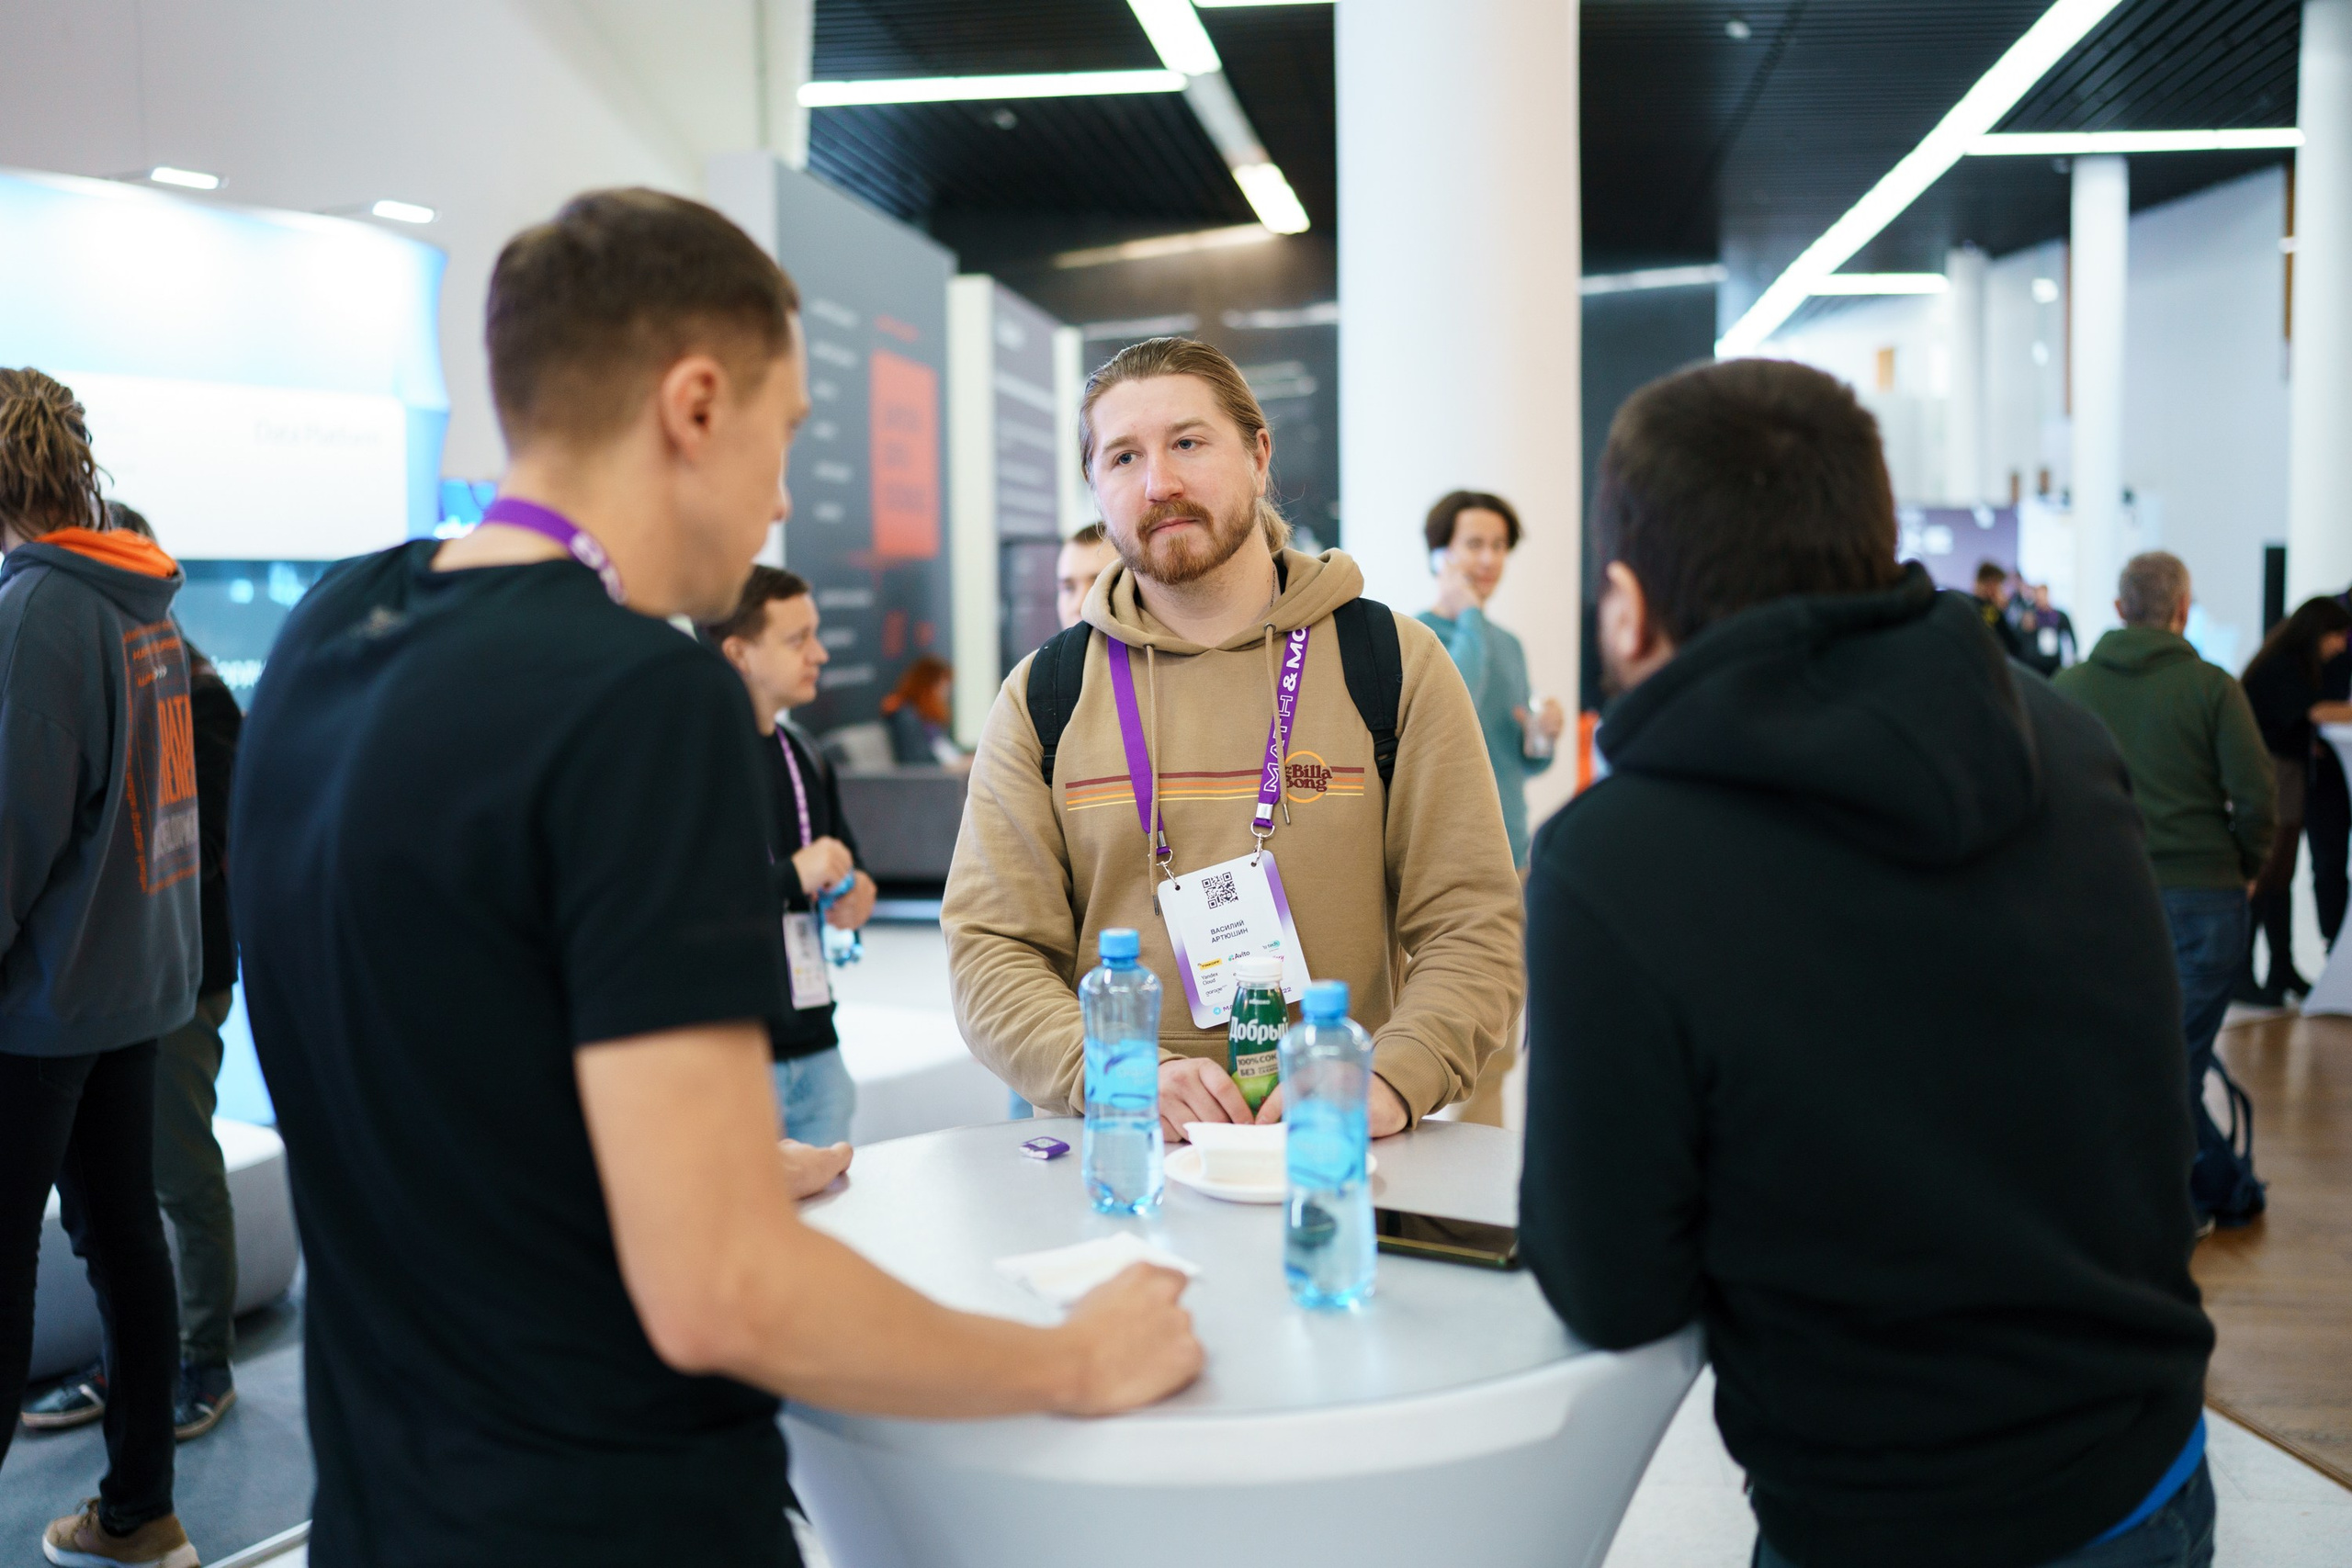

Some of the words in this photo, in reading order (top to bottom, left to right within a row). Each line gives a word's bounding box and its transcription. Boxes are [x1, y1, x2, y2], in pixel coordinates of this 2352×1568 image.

[1210, 919, 1245, 935] ВАСИЛИЙ
[1211, 928, 1249, 943] АРТЮШИН
[1201, 972, 1218, 980] Yandex
[1238, 1057, 1259, 1066] 100%
[1240, 1068, 1255, 1077] БЕЗ
